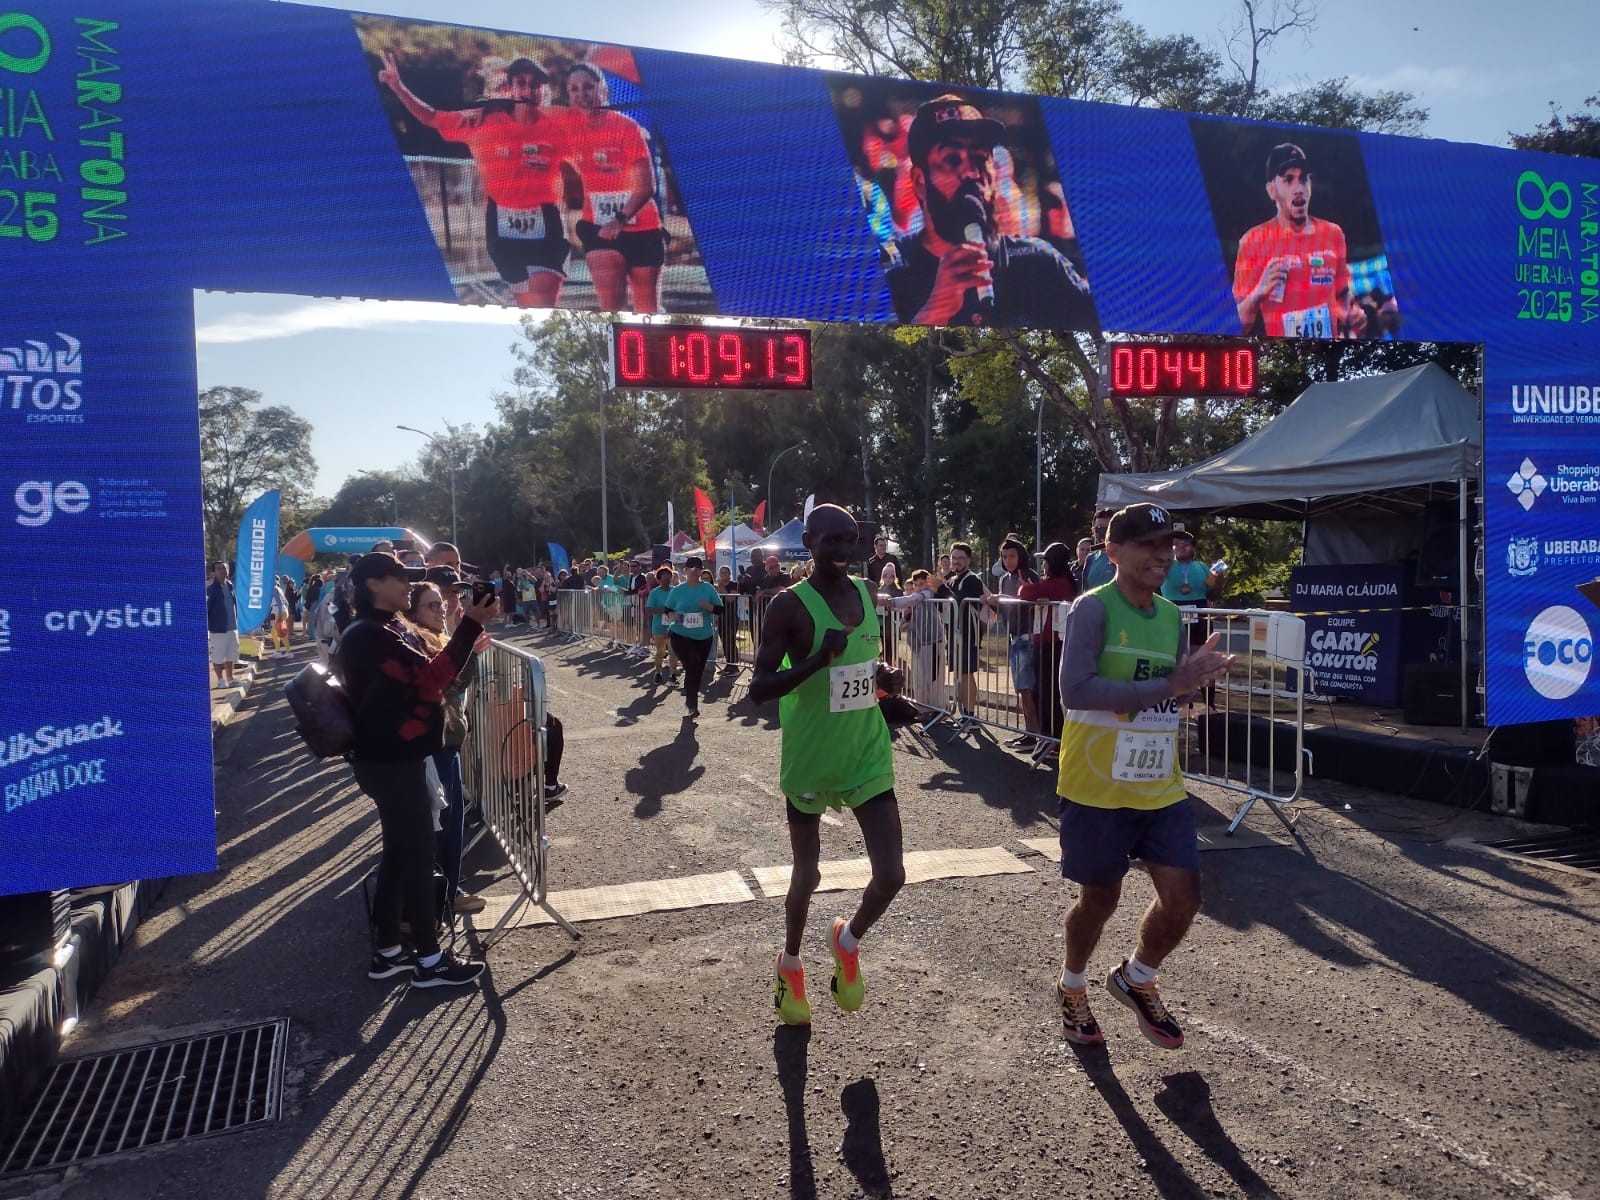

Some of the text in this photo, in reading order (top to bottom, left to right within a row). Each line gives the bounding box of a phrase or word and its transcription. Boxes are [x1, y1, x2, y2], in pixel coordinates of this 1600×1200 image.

[74, 16, 128, 245] MARATONA
[1518, 225, 1572, 260] MEIA
[1580, 182, 1599, 323] MARATONA
[1514, 263, 1574, 284] UBERABA
[1517, 289, 1572, 322] 2025
[0, 375, 83, 410] TOS
[1513, 415, 1564, 424] UNIVERSIDADE
[1565, 415, 1575, 424] DE
[14, 480, 91, 526] ge
[1562, 495, 1597, 504] Viva Bem
[1296, 582, 1398, 596] DJ MARIA CLÁUDIA
[44, 601, 172, 636] crystal
[1327, 618, 1356, 627] EQUIPE
[1310, 629, 1371, 652] GARY
[1330, 681, 1364, 690] CONQUISTA
[1126, 748, 1165, 770] 1031
